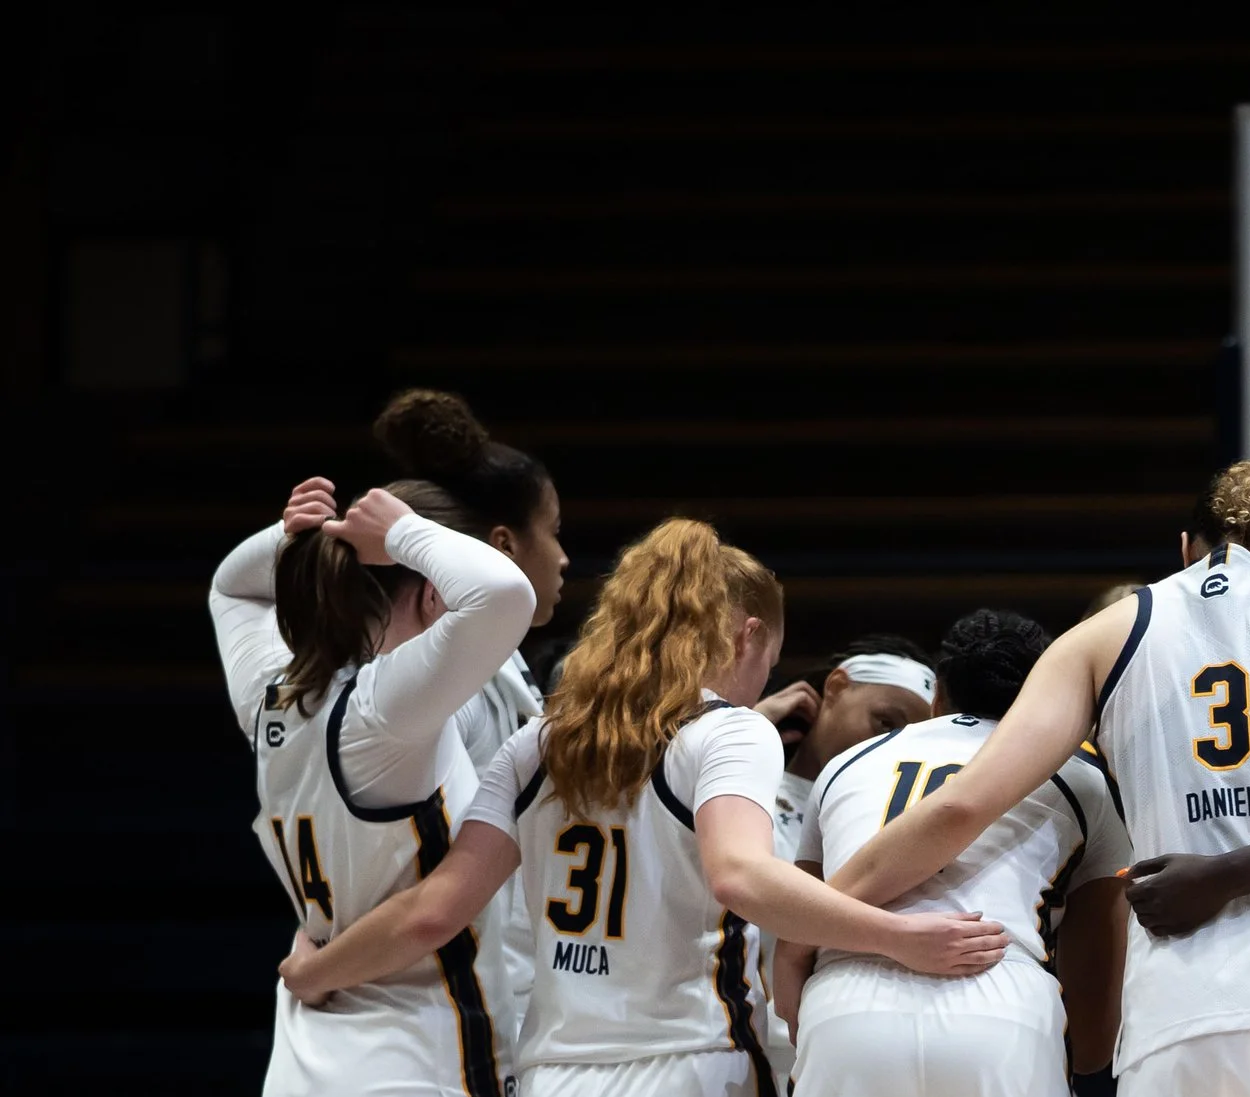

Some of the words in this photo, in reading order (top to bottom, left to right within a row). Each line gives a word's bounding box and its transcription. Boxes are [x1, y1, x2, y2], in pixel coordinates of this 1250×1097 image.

[271, 815, 335, 922] 14
[545, 821, 629, 941] 31
[552, 940, 610, 976] MUCA
